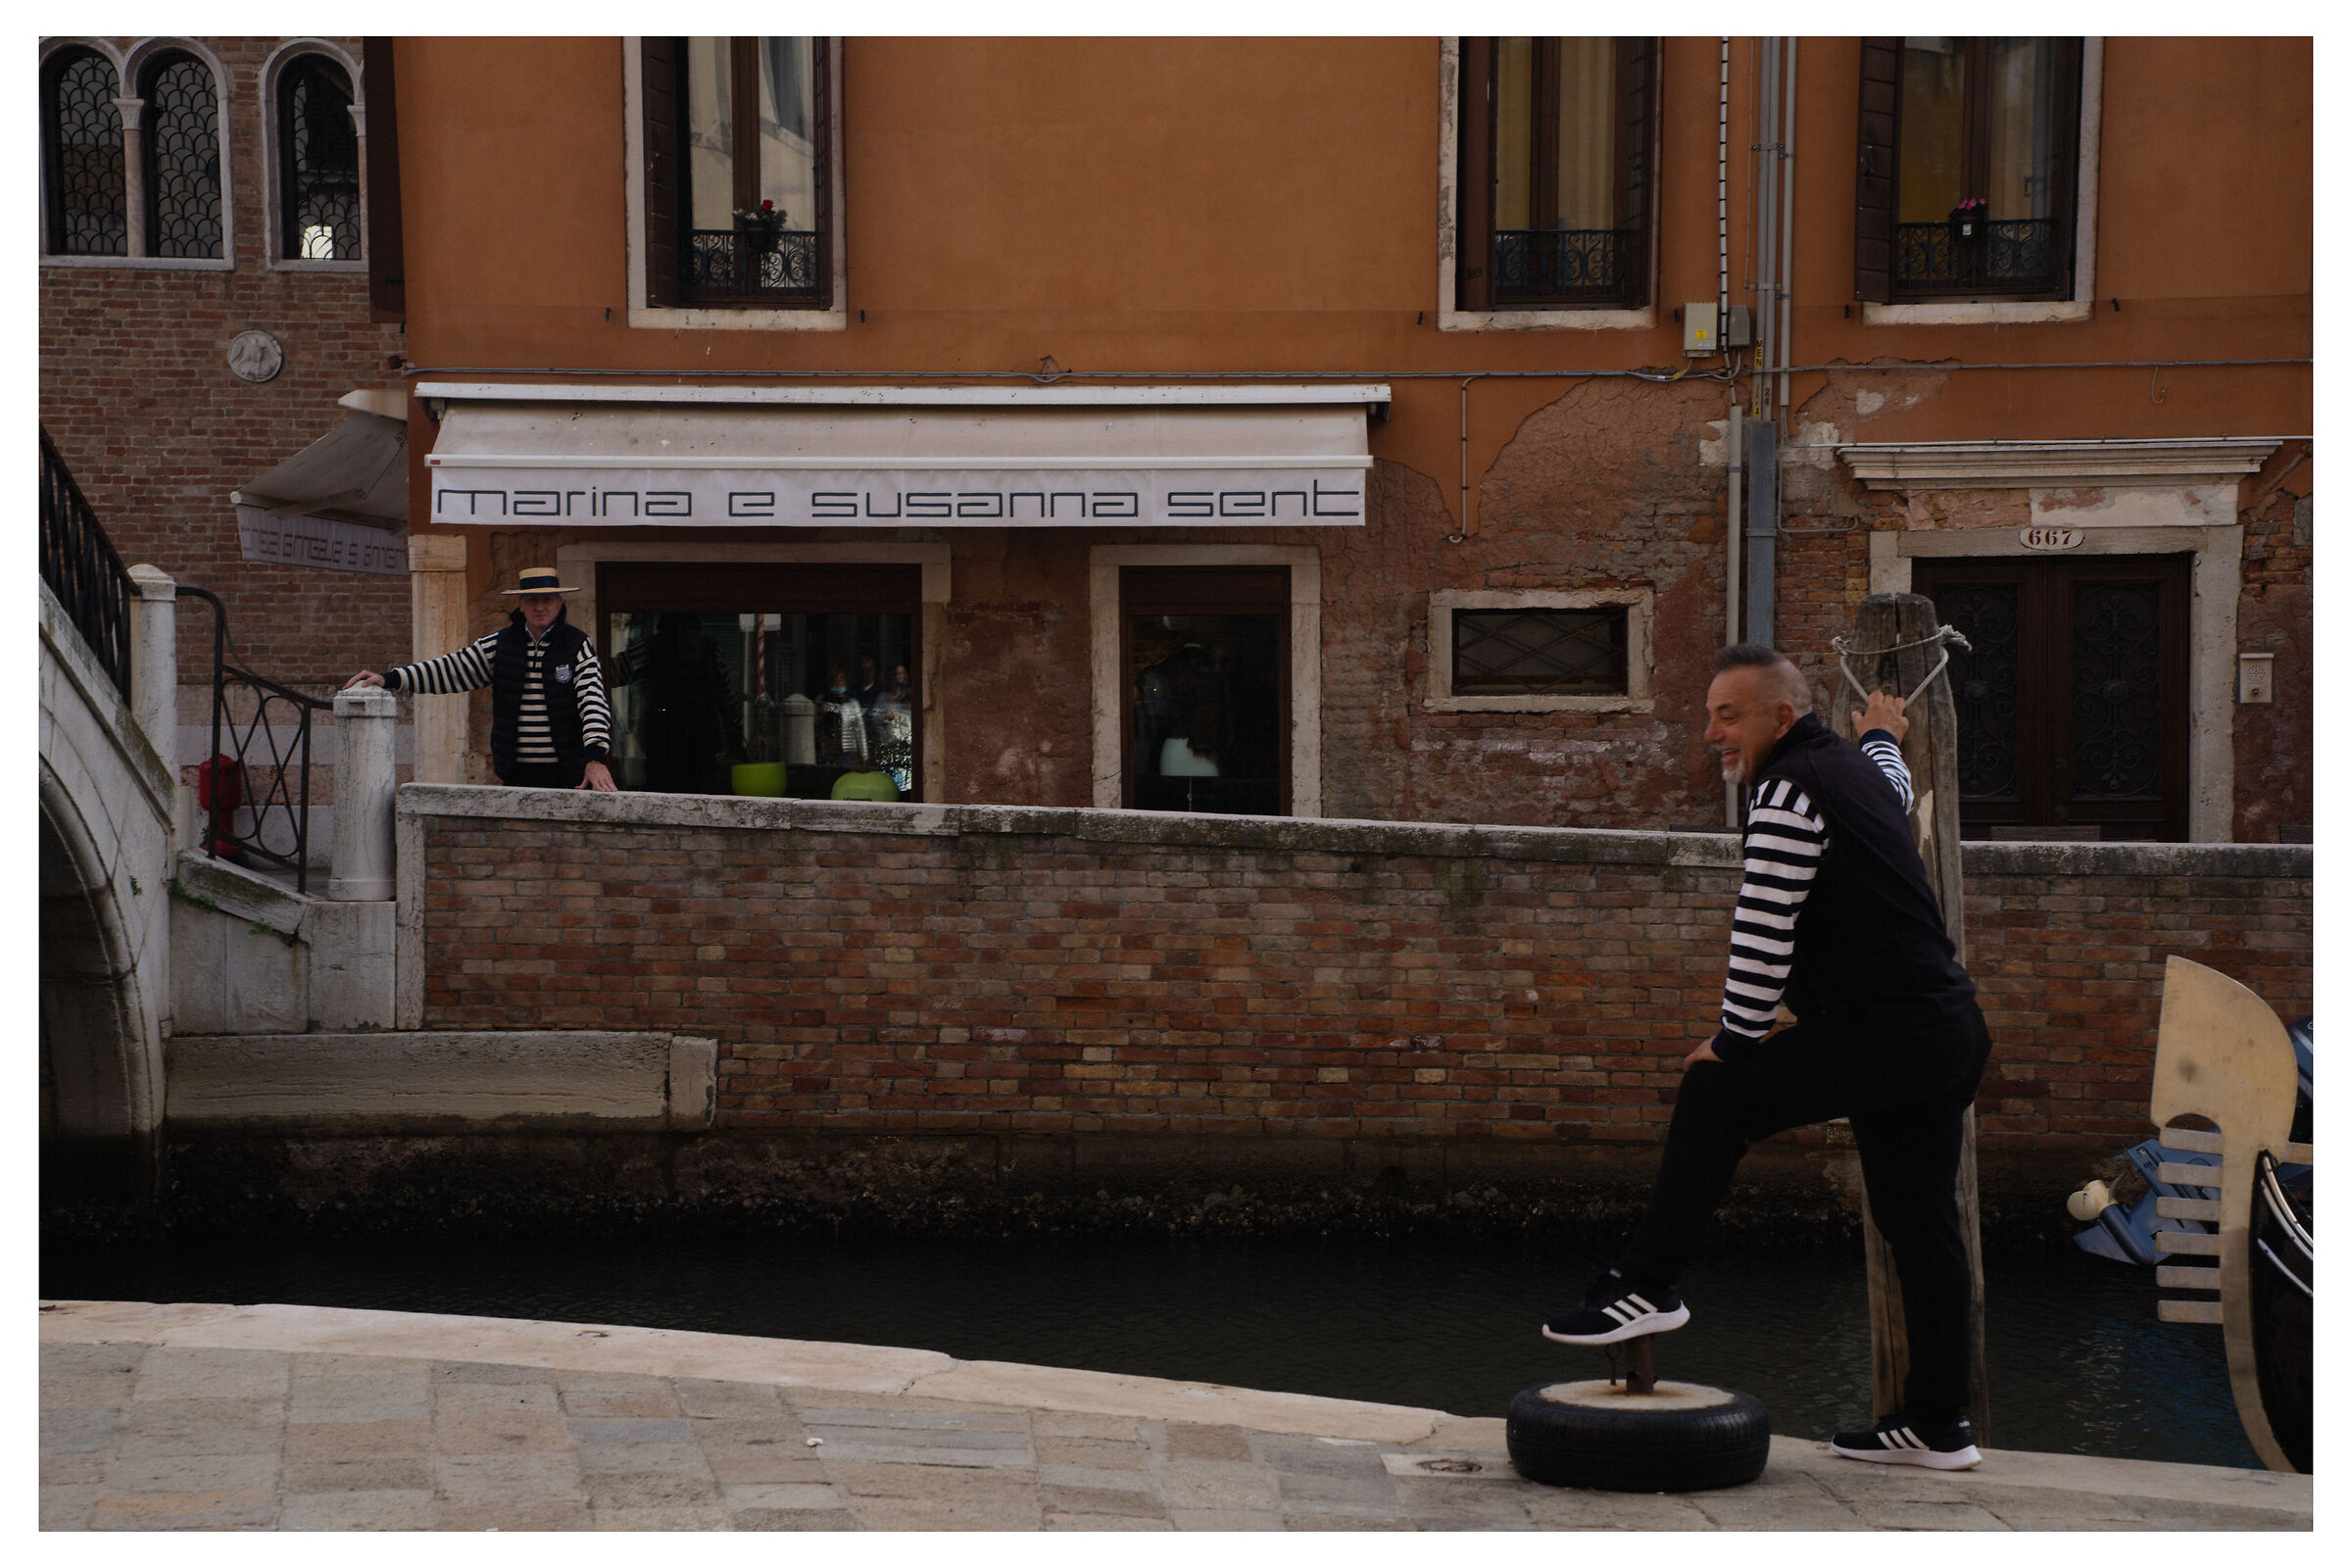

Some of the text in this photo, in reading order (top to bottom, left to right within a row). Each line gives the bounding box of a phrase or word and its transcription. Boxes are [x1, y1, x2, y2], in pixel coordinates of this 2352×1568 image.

[436, 479, 1360, 518] marina e susanna sent
[2029, 529, 2072, 546] 667
